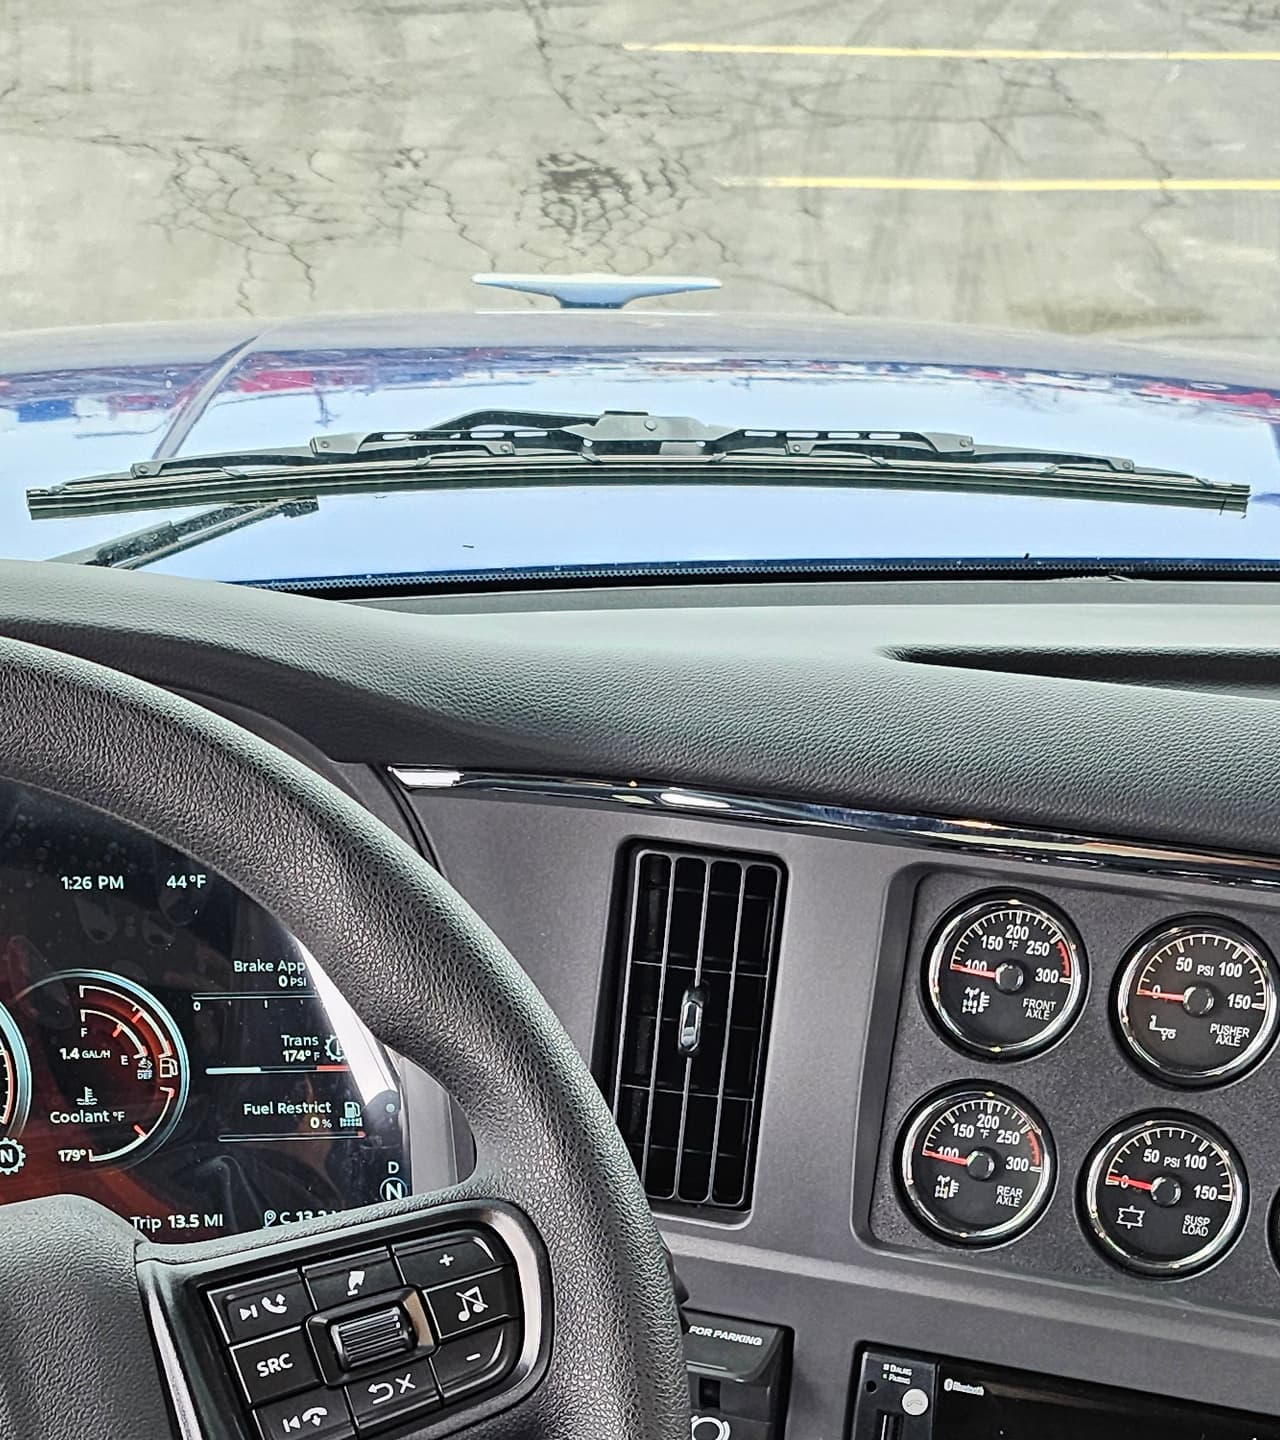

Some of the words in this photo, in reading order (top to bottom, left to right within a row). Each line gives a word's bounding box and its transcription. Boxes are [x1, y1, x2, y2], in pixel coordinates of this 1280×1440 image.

[61, 876, 92, 890] 1:26
[98, 876, 124, 890] PM
[1006, 924, 1029, 940] 200
[980, 936, 1003, 951] 150
[1026, 940, 1050, 957] 250
[233, 959, 274, 973] Brake
[277, 960, 306, 975] App
[1176, 957, 1193, 972] 50
[1197, 965, 1214, 977] PSI
[1219, 962, 1243, 978] 100
[278, 976, 288, 988] 0
[290, 977, 307, 987] PSI
[1035, 968, 1059, 983] 300
[1023, 998, 1056, 1011] FRONT
[1227, 993, 1251, 1010] 150
[1025, 1008, 1050, 1021] AXLE
[81, 1028, 89, 1038] F
[1210, 1024, 1250, 1038] PUSHER
[281, 1034, 319, 1047] Trans
[1216, 1035, 1241, 1047] AXLE
[59, 1047, 80, 1060] 1.4
[82, 1050, 111, 1059] GAL/H
[120, 1055, 129, 1066] E
[244, 1102, 274, 1115] Fuel
[277, 1101, 332, 1115] Restrict
[50, 1110, 110, 1124] Coolant
[310, 1117, 320, 1129] 0
[976, 1114, 999, 1129] 200
[952, 1123, 974, 1138] 150
[996, 1129, 1020, 1145] 250
[0, 1149, 13, 1163] N
[1143, 1149, 1160, 1163] 50
[1164, 1157, 1180, 1168] PSI
[1184, 1154, 1207, 1170] 100
[388, 1161, 400, 1174] D
[1006, 1156, 1029, 1172] 300
[386, 1182, 402, 1201] N
[997, 1185, 1023, 1198] REAR
[1193, 1184, 1218, 1200] 150
[996, 1195, 1020, 1208] AXLE
[130, 1214, 162, 1234] Trip
[167, 1214, 200, 1229] 13.5
[204, 1213, 224, 1228] MI
[1184, 1214, 1211, 1227] SUSP
[1182, 1225, 1209, 1237] LOAD
[688, 1325, 713, 1337] FOR
[713, 1330, 763, 1346] PARKING
[256, 1353, 294, 1377] SRC
